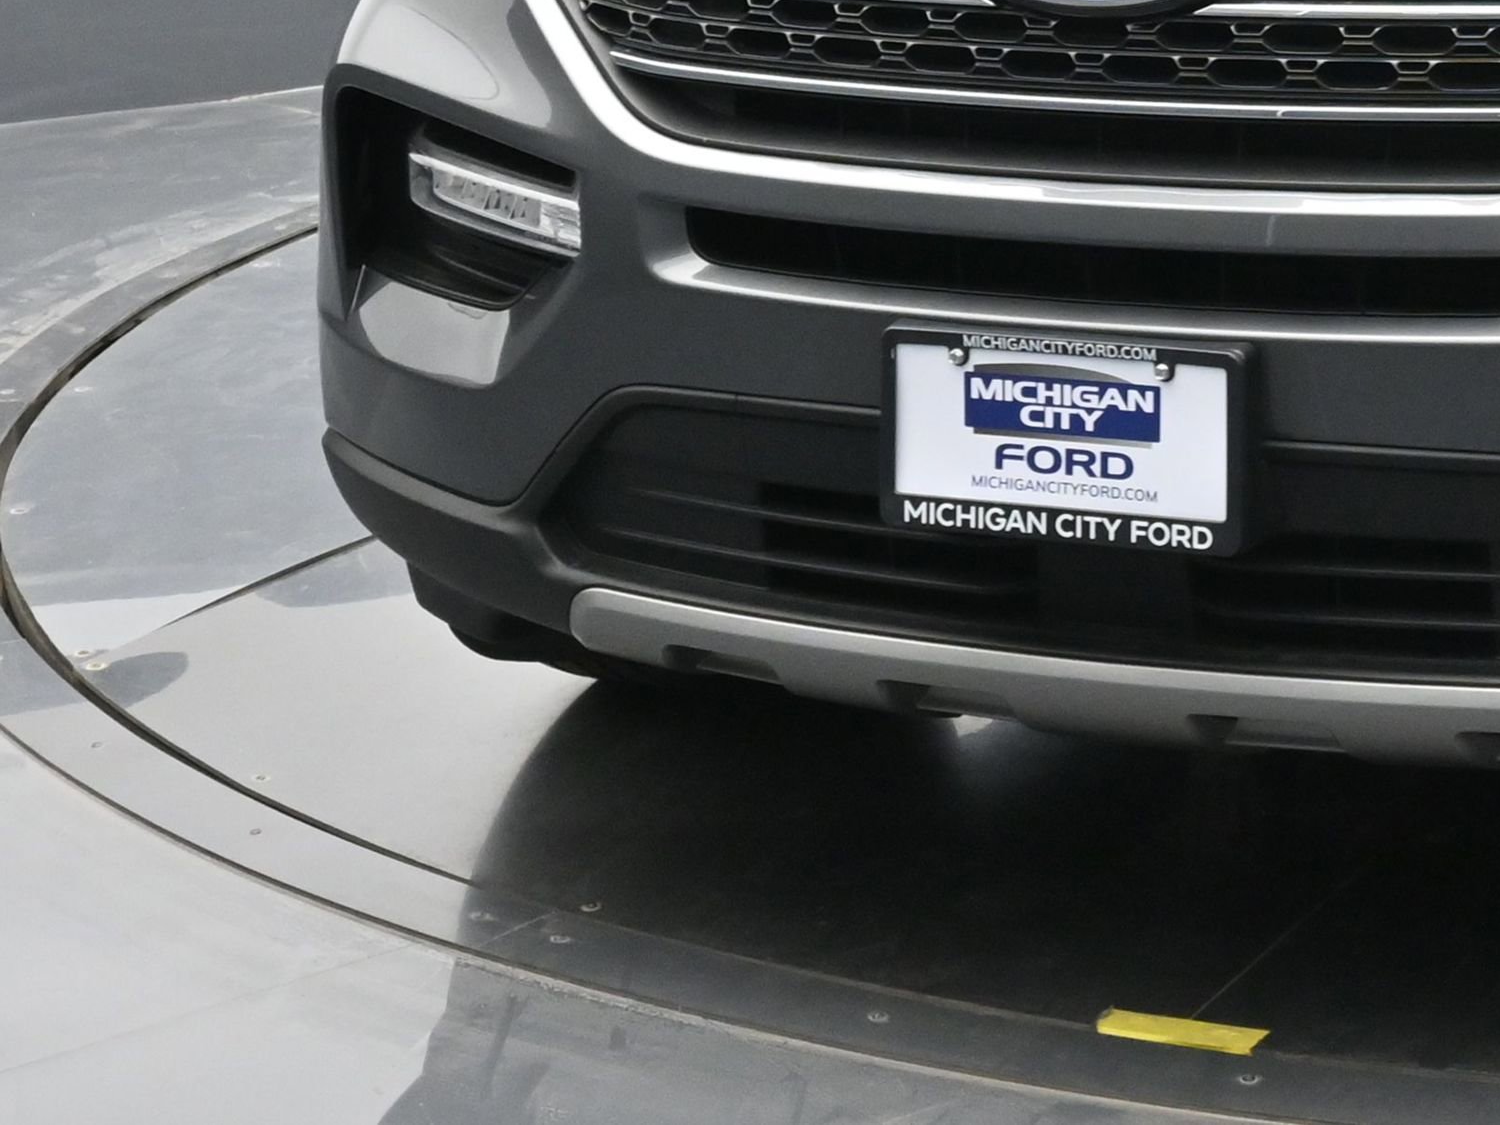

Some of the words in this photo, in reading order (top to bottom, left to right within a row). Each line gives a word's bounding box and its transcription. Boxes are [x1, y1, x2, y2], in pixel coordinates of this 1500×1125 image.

[962, 335, 1157, 361] MICHIGANCITYFORD.COM
[970, 377, 1155, 413] MICHIGAN
[1019, 406, 1104, 432] CITY
[994, 443, 1134, 480] FORD
[971, 475, 1159, 503] MICHIGANCITYFORD.COM
[903, 500, 1047, 536] MICHIGAN
[1055, 513, 1122, 543] CITY
[1130, 520, 1213, 551] FORD
